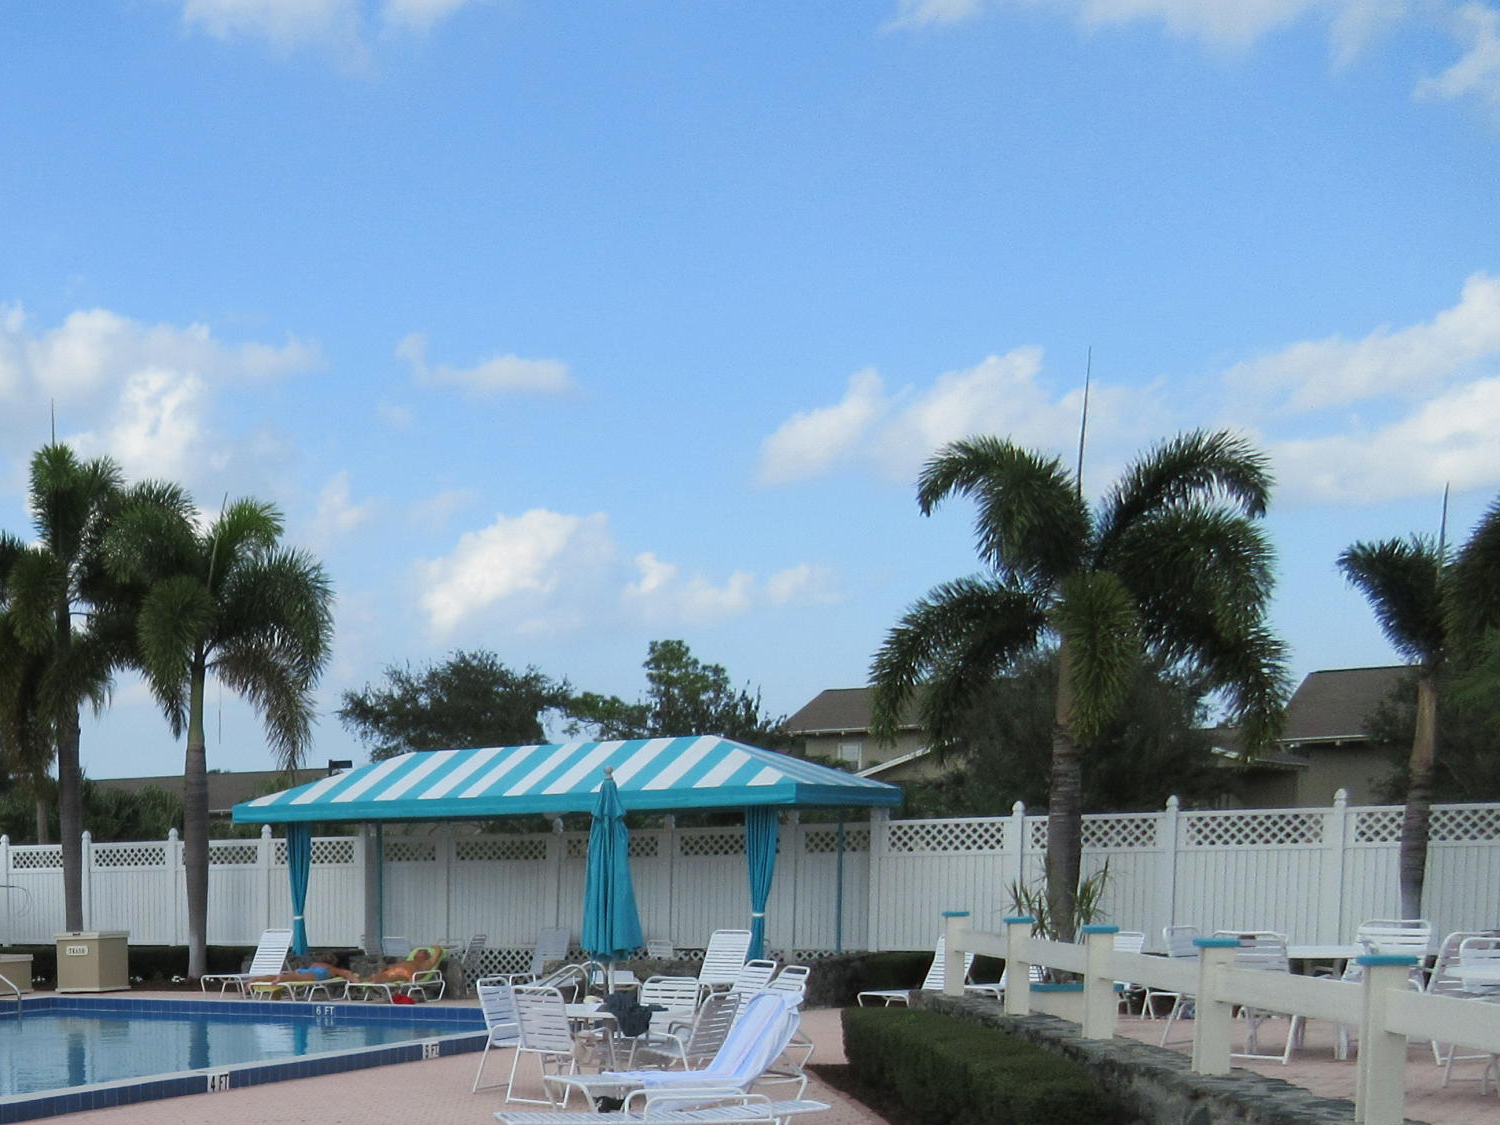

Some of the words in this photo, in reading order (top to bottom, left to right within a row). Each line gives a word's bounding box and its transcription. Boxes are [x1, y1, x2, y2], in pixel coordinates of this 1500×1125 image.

[325, 1006, 335, 1015] FT
[211, 1075, 215, 1092] 4
[219, 1073, 228, 1091] FT
